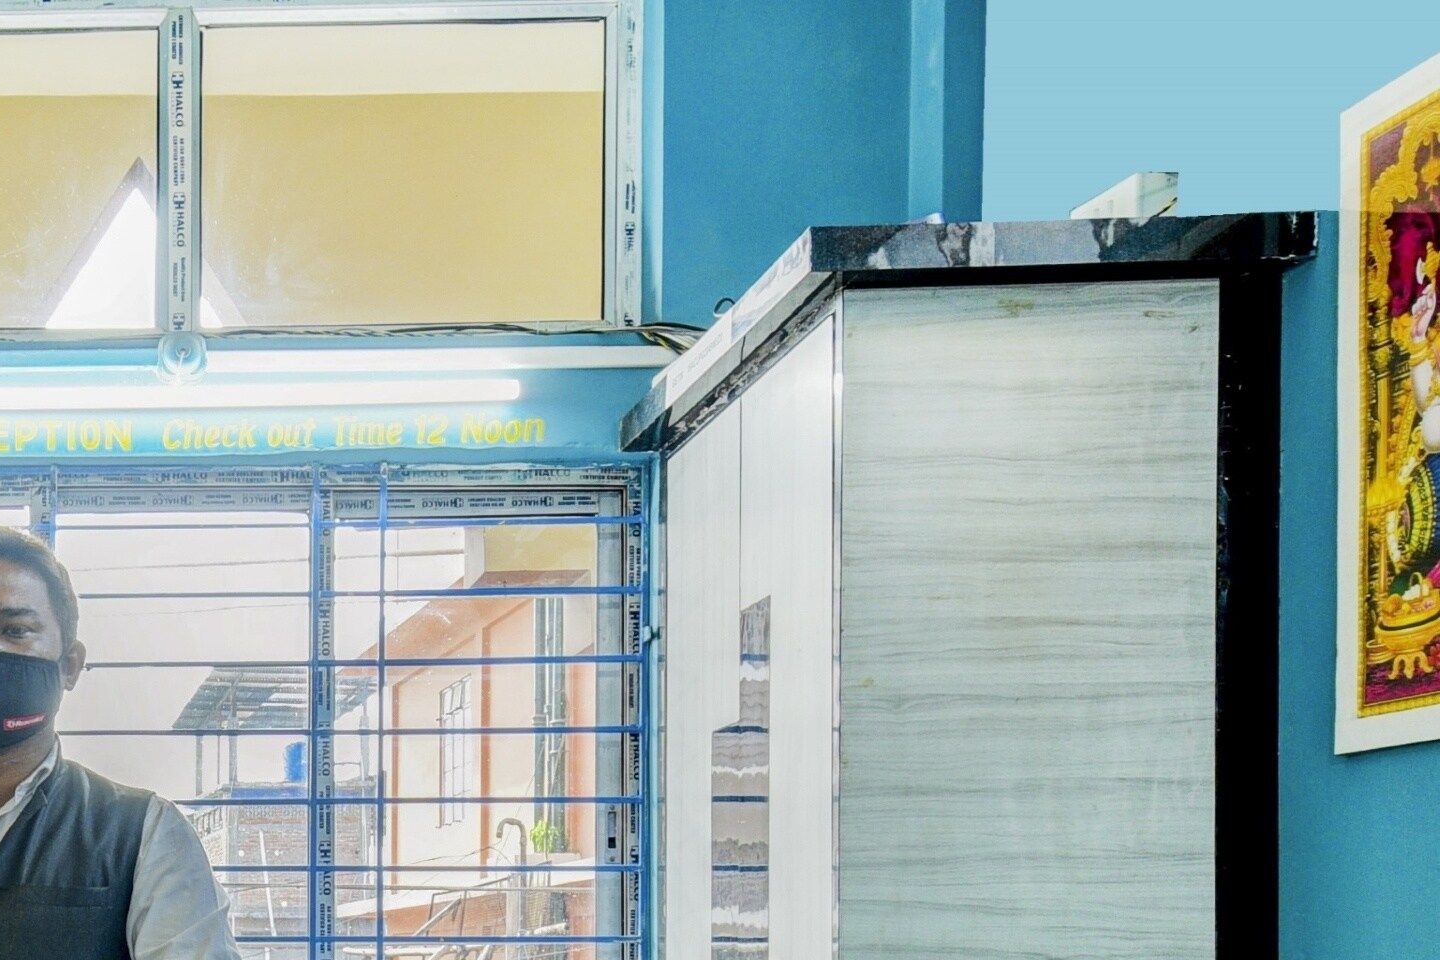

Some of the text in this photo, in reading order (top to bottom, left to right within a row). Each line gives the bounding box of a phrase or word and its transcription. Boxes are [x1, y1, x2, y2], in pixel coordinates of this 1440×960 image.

[176, 92, 184, 128] HALCO
[176, 212, 185, 248] HALCO
[162, 417, 257, 450] Check
[266, 418, 317, 448] out
[333, 415, 404, 447] Time
[414, 415, 449, 446] 12
[460, 415, 546, 445] Noon
[291, 470, 328, 478] HALO
[63, 496, 90, 506] HALCO
[152, 496, 182, 504] HALCO
[243, 494, 272, 504] HALCO
[422, 498, 450, 507] HALCO
[512, 498, 540, 507] HALCO
[322, 500, 330, 536] HALO
[322, 620, 330, 656] HALCO
[322, 740, 330, 776] HALCO
